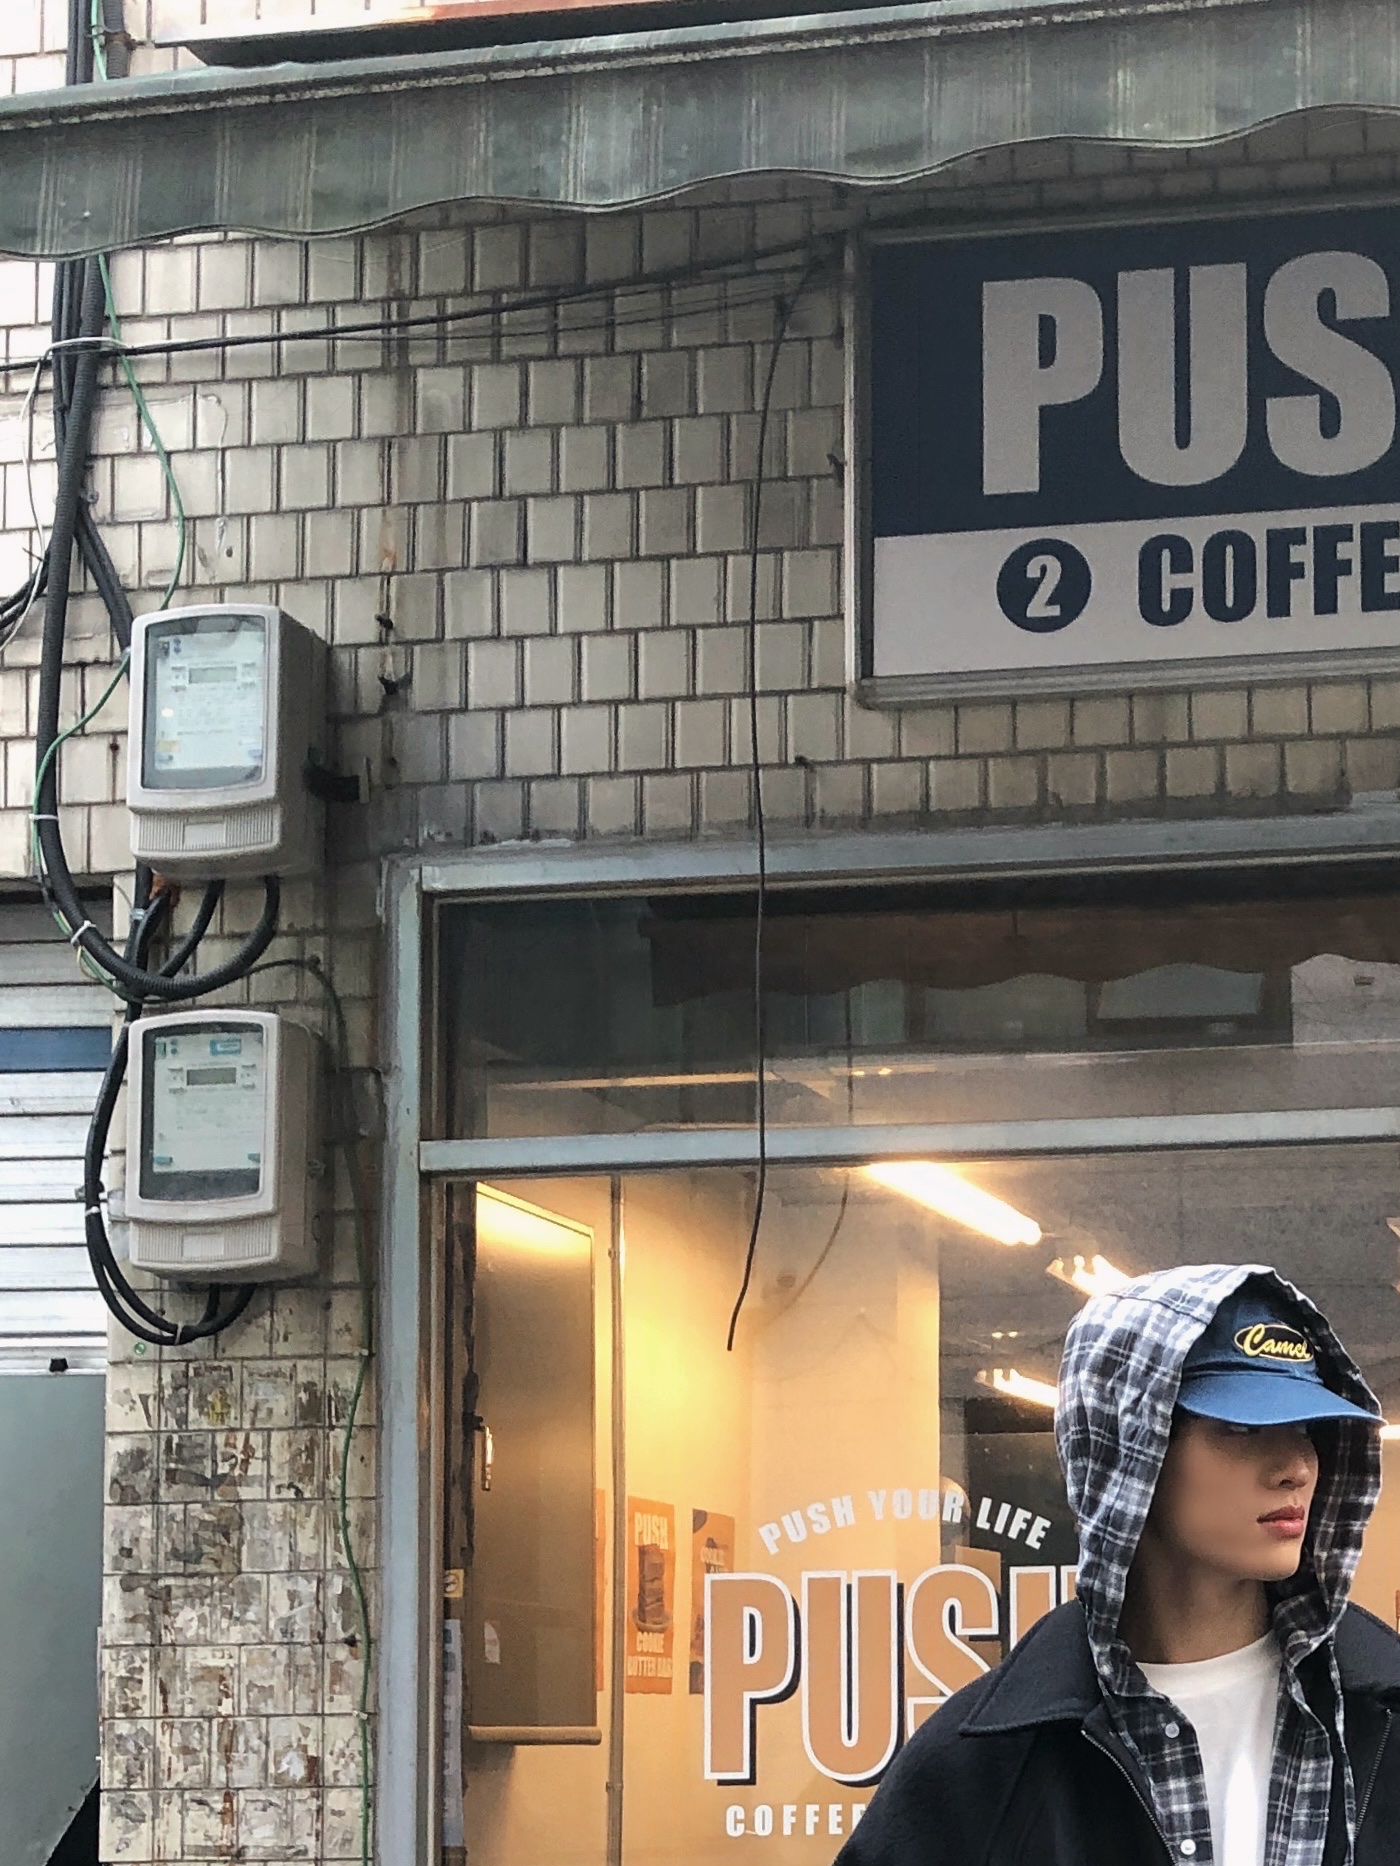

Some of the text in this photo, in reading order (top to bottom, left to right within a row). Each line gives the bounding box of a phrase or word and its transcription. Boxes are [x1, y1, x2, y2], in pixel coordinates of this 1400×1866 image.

[1243, 1323, 1311, 1358] Camel
[633, 1511, 669, 1550] PUSH
[758, 1488, 1052, 1555] PUSH YOUR LIFE
